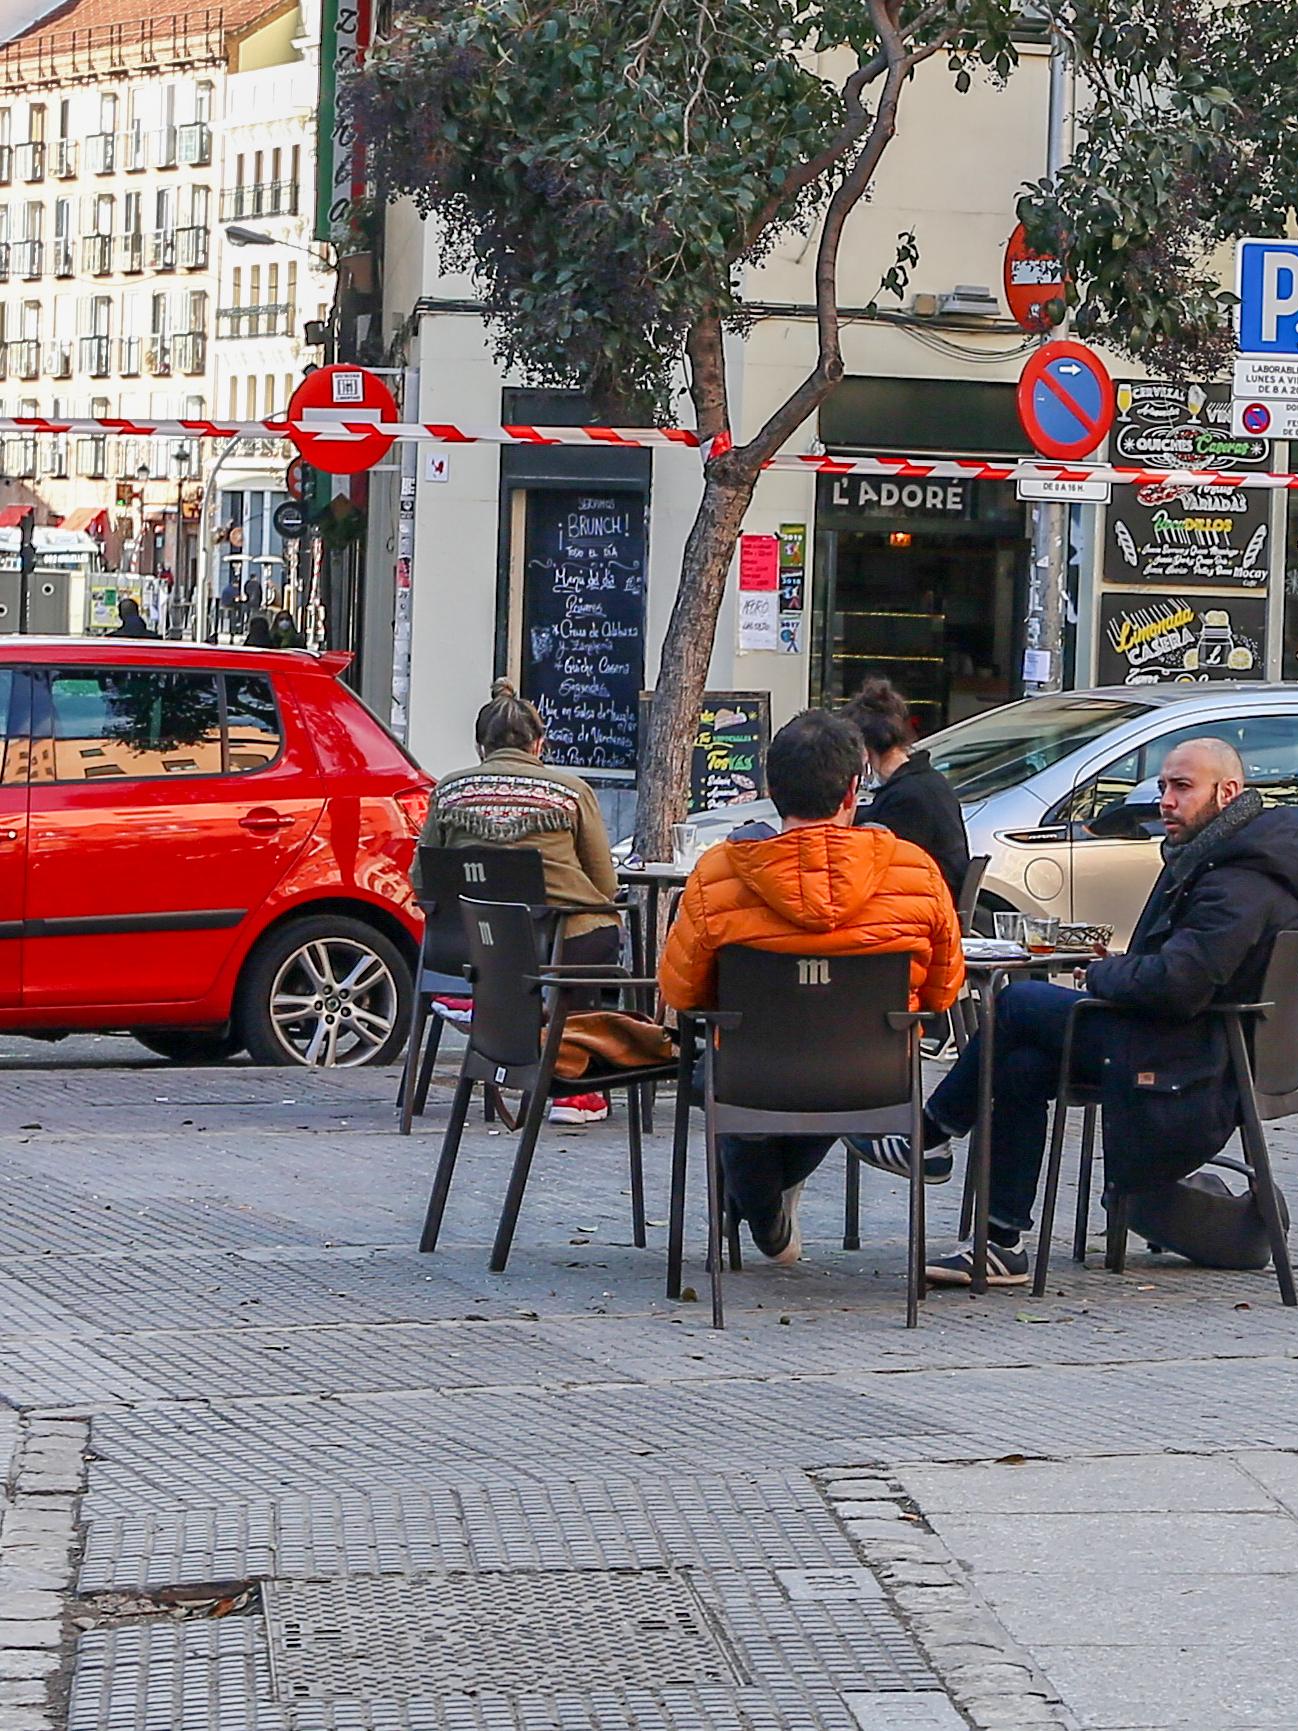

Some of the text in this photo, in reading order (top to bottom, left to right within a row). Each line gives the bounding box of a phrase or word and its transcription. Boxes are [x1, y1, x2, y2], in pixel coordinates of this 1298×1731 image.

[1245, 375, 1276, 385] LUNES
[1278, 376, 1285, 385] A
[1257, 385, 1270, 394] DE
[1272, 385, 1279, 395] 8
[1281, 386, 1288, 395] A
[1282, 427, 1294, 436] DE
[1136, 437, 1193, 452] QUICHES
[1042, 482, 1053, 491] DE
[1232, 566, 1269, 581] Mocay
[1115, 607, 1194, 654] Limonada
[1127, 627, 1196, 666] CASERA
[796, 959, 832, 985] m
